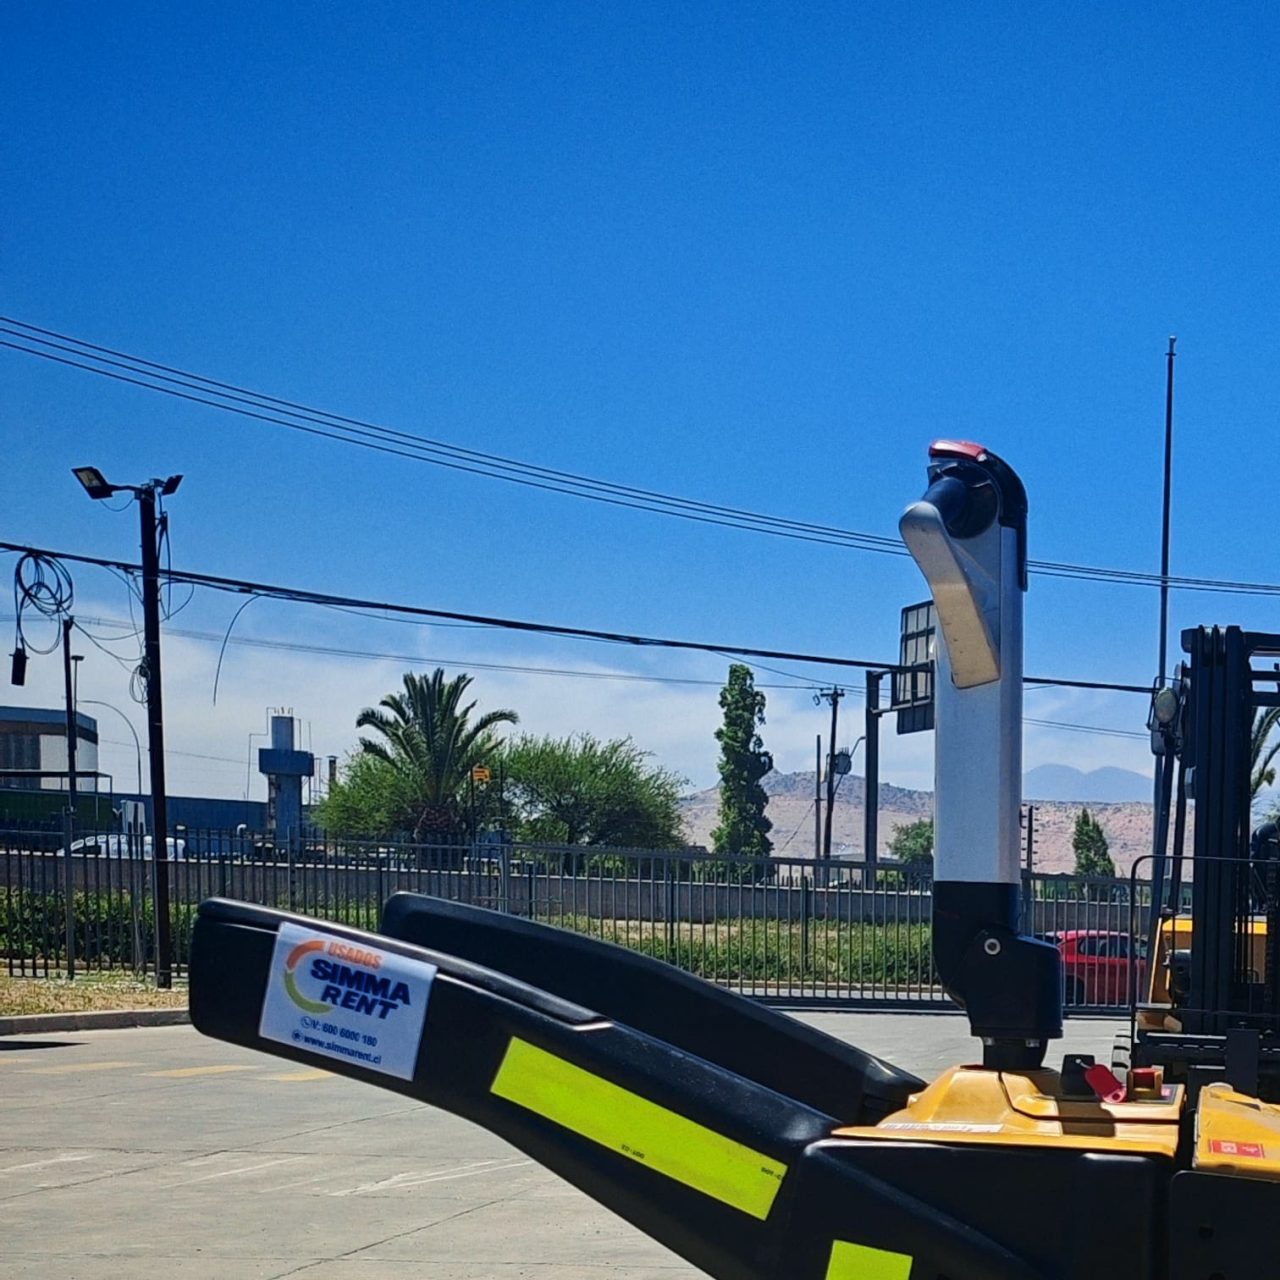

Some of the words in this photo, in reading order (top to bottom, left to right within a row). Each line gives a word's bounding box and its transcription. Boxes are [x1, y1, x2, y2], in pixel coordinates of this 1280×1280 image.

[328, 942, 383, 969] USADOS
[310, 958, 411, 1006] SIMMA
[320, 985, 398, 1019] RENT
[322, 1023, 339, 1036] 600
